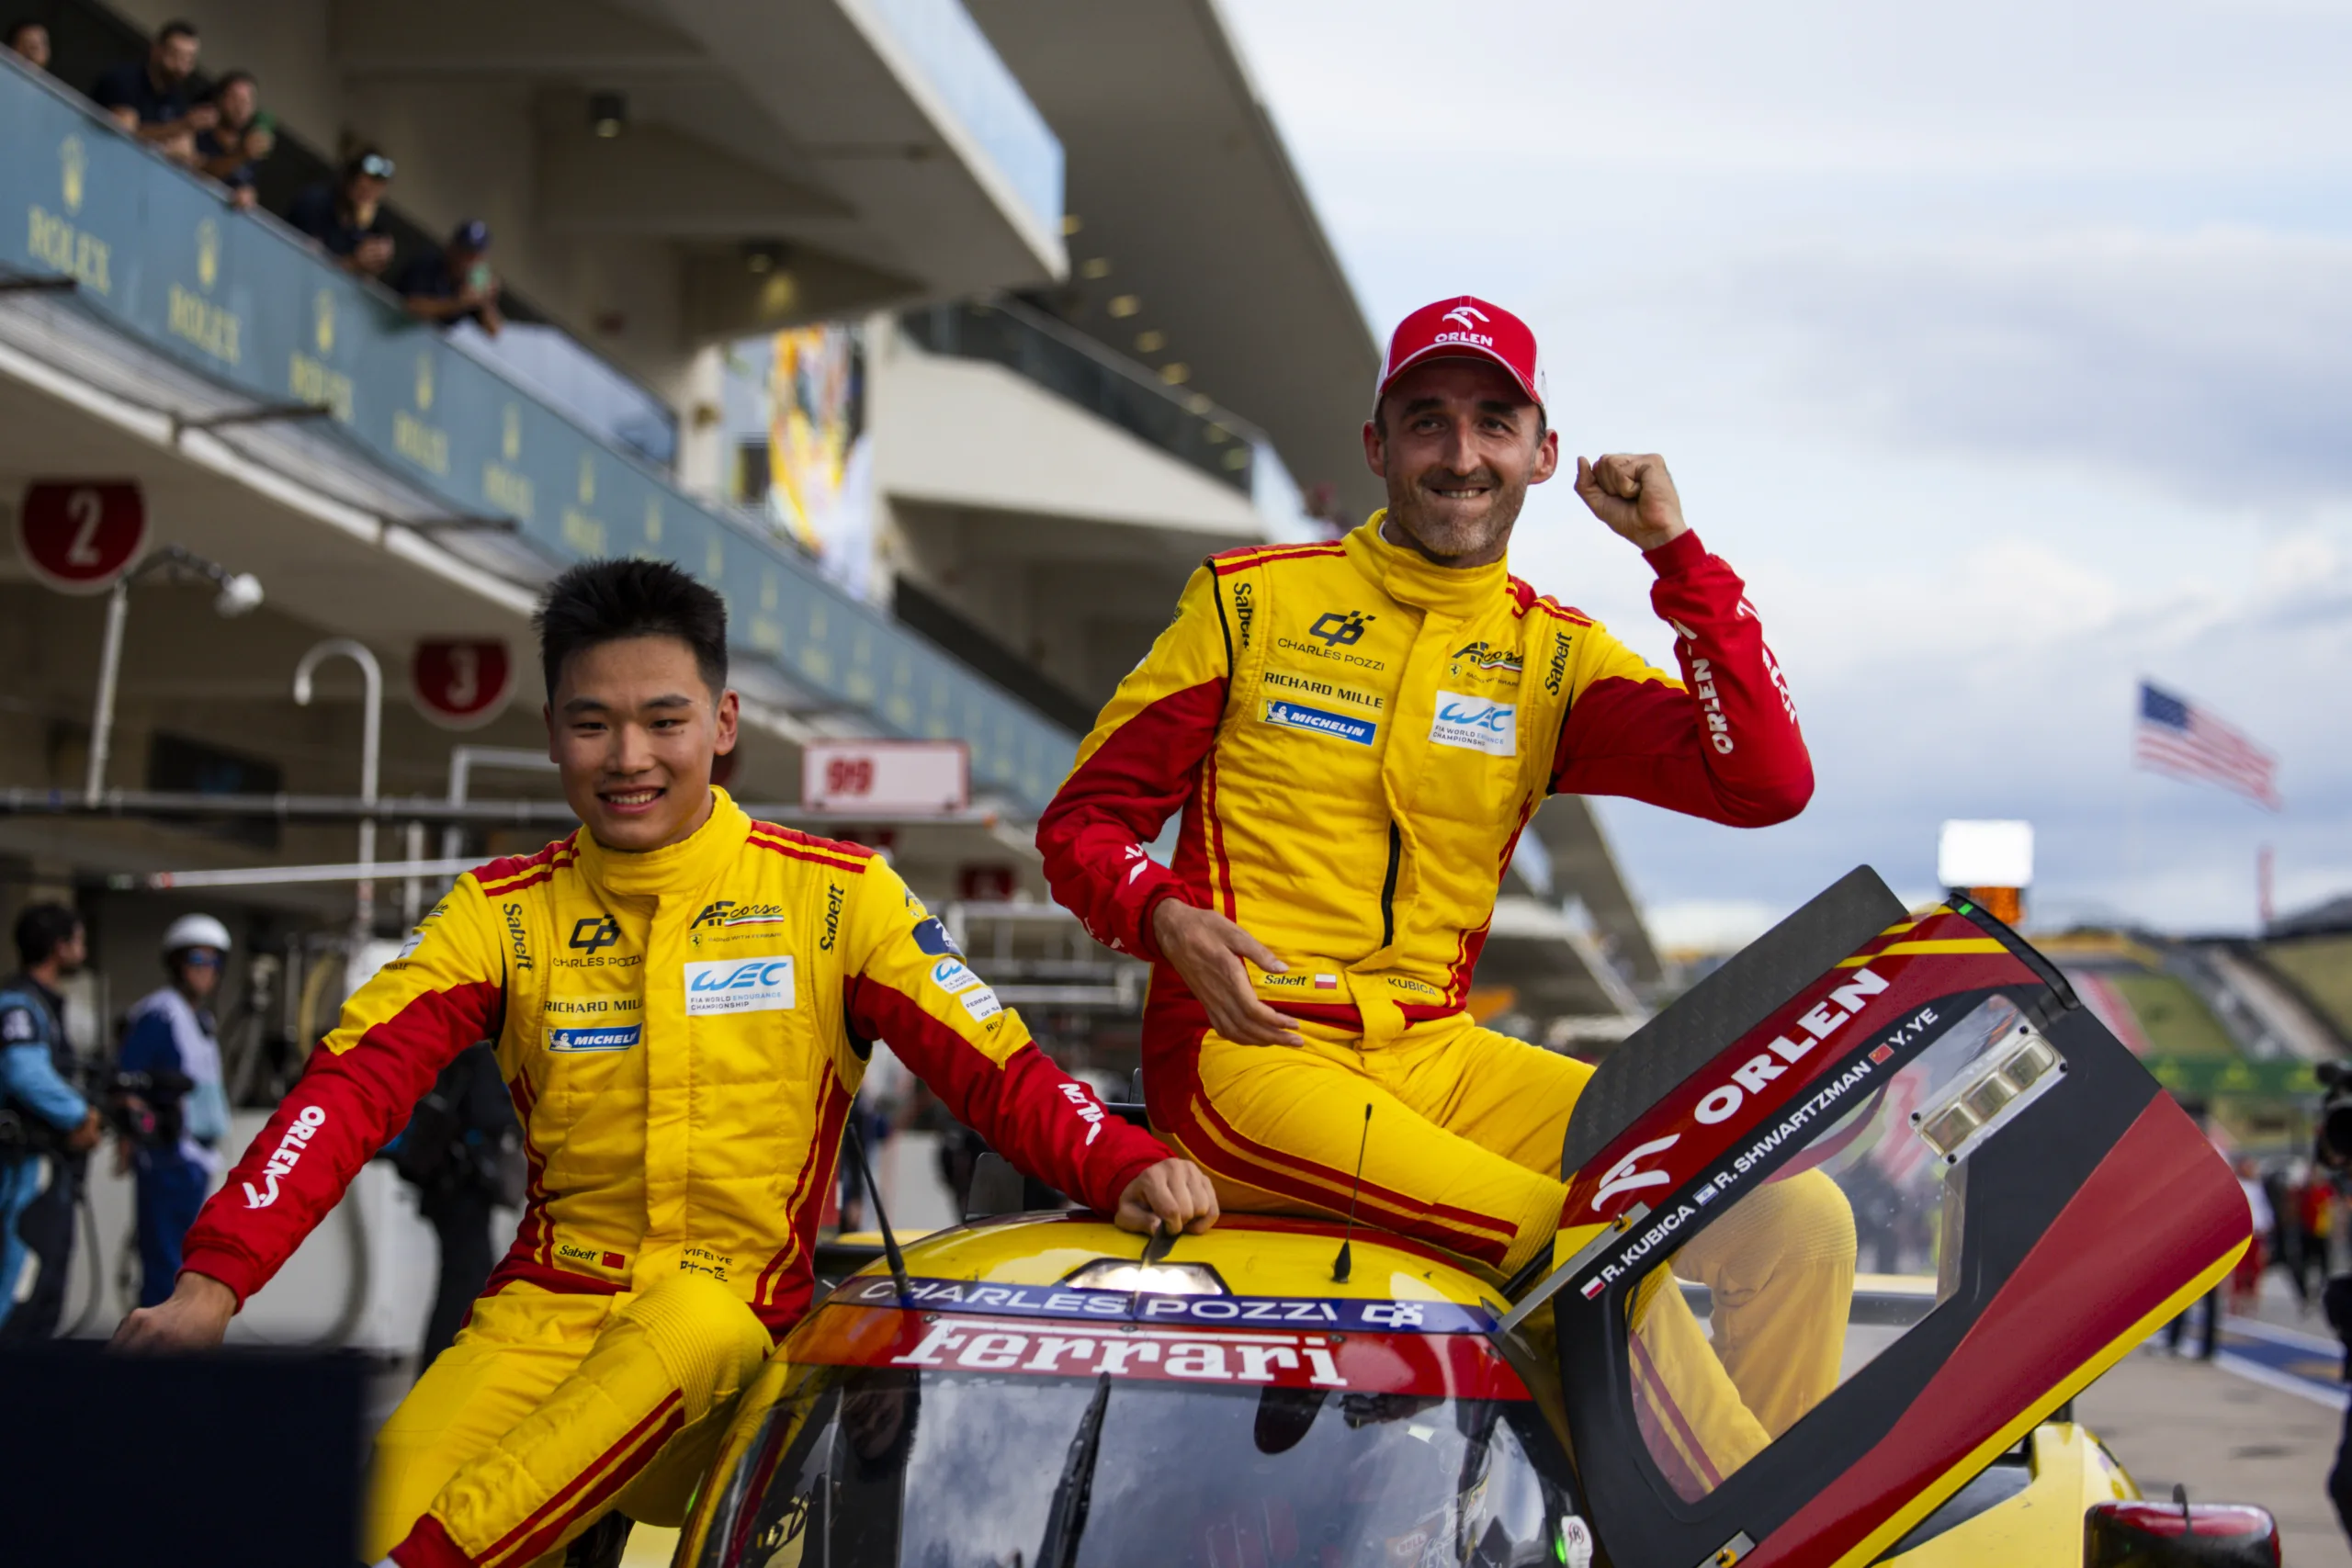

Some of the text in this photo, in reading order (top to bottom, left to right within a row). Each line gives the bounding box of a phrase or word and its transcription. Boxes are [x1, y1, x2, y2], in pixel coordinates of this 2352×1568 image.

[1434, 332, 1493, 346] ORLEN
[67, 488, 104, 566] 2
[1278, 637, 1385, 671] CHARLES POZZI
[1544, 631, 1572, 696] Sabelt
[446, 645, 478, 707] 3
[1264, 672, 1384, 708] RICHARD MILLE
[1692, 658, 1734, 754] ORLEN
[1291, 712, 1365, 737] MICHELIN
[1435, 725, 1445, 733] FIA
[1446, 728, 1476, 738] WORLD
[827, 758, 874, 795] 99
[820, 882, 844, 955] Sabelt
[503, 903, 533, 972] Sabelt
[691, 962, 787, 991] WEC
[1264, 974, 1307, 987] Sabelt
[1387, 977, 1437, 997] KUBICA
[544, 1001, 607, 1013] RICHARD
[691, 1001, 750, 1011] CHAMPIONSHIP
[732, 991, 781, 1001] ENDURANCE
[1694, 967, 1890, 1125] ORLEN
[262, 1105, 325, 1179] ORLEN
[559, 1245, 598, 1261] Sabelt
[684, 1248, 733, 1266] YIFEI YE
[680, 1260, 729, 1282] 叶一飞
[859, 1280, 1127, 1314] CHARLES
[1146, 1299, 1338, 1321] POZZI
[890, 1319, 1348, 1385] Ferrari
